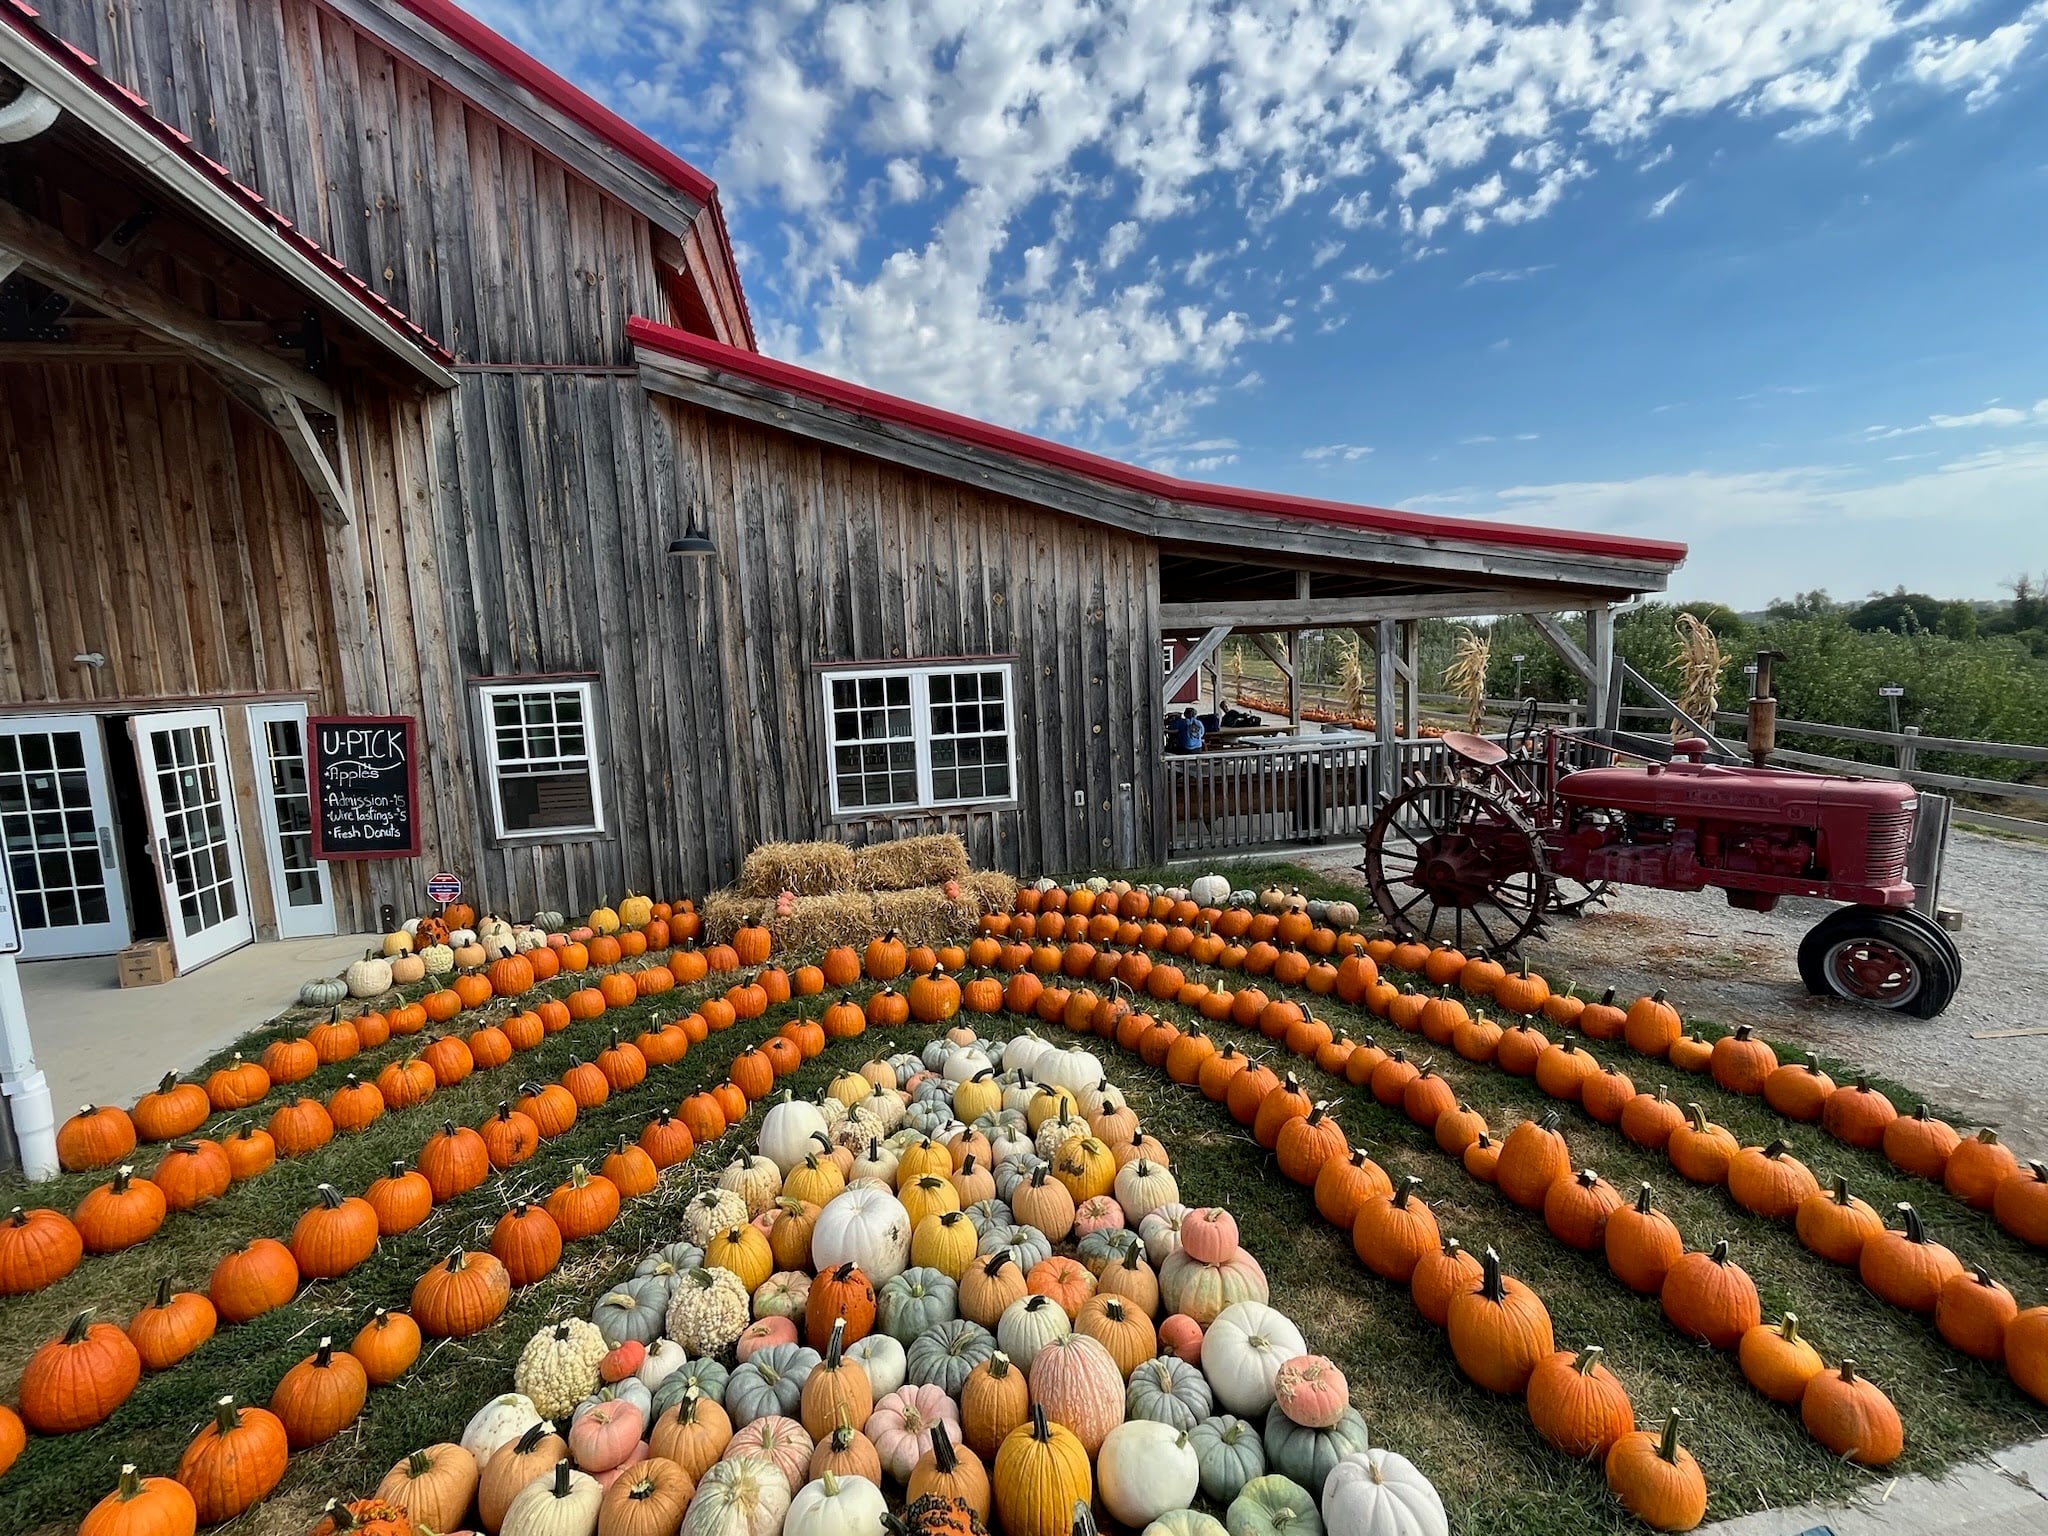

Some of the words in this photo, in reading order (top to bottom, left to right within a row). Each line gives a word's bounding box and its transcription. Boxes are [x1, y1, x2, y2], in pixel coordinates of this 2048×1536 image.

[323, 729, 406, 762] U-PICK
[330, 766, 380, 788] Apples
[328, 791, 389, 808] Admission
[351, 806, 394, 826] Tastings
[333, 825, 361, 839] Fresh
[363, 823, 401, 839] Donuts
